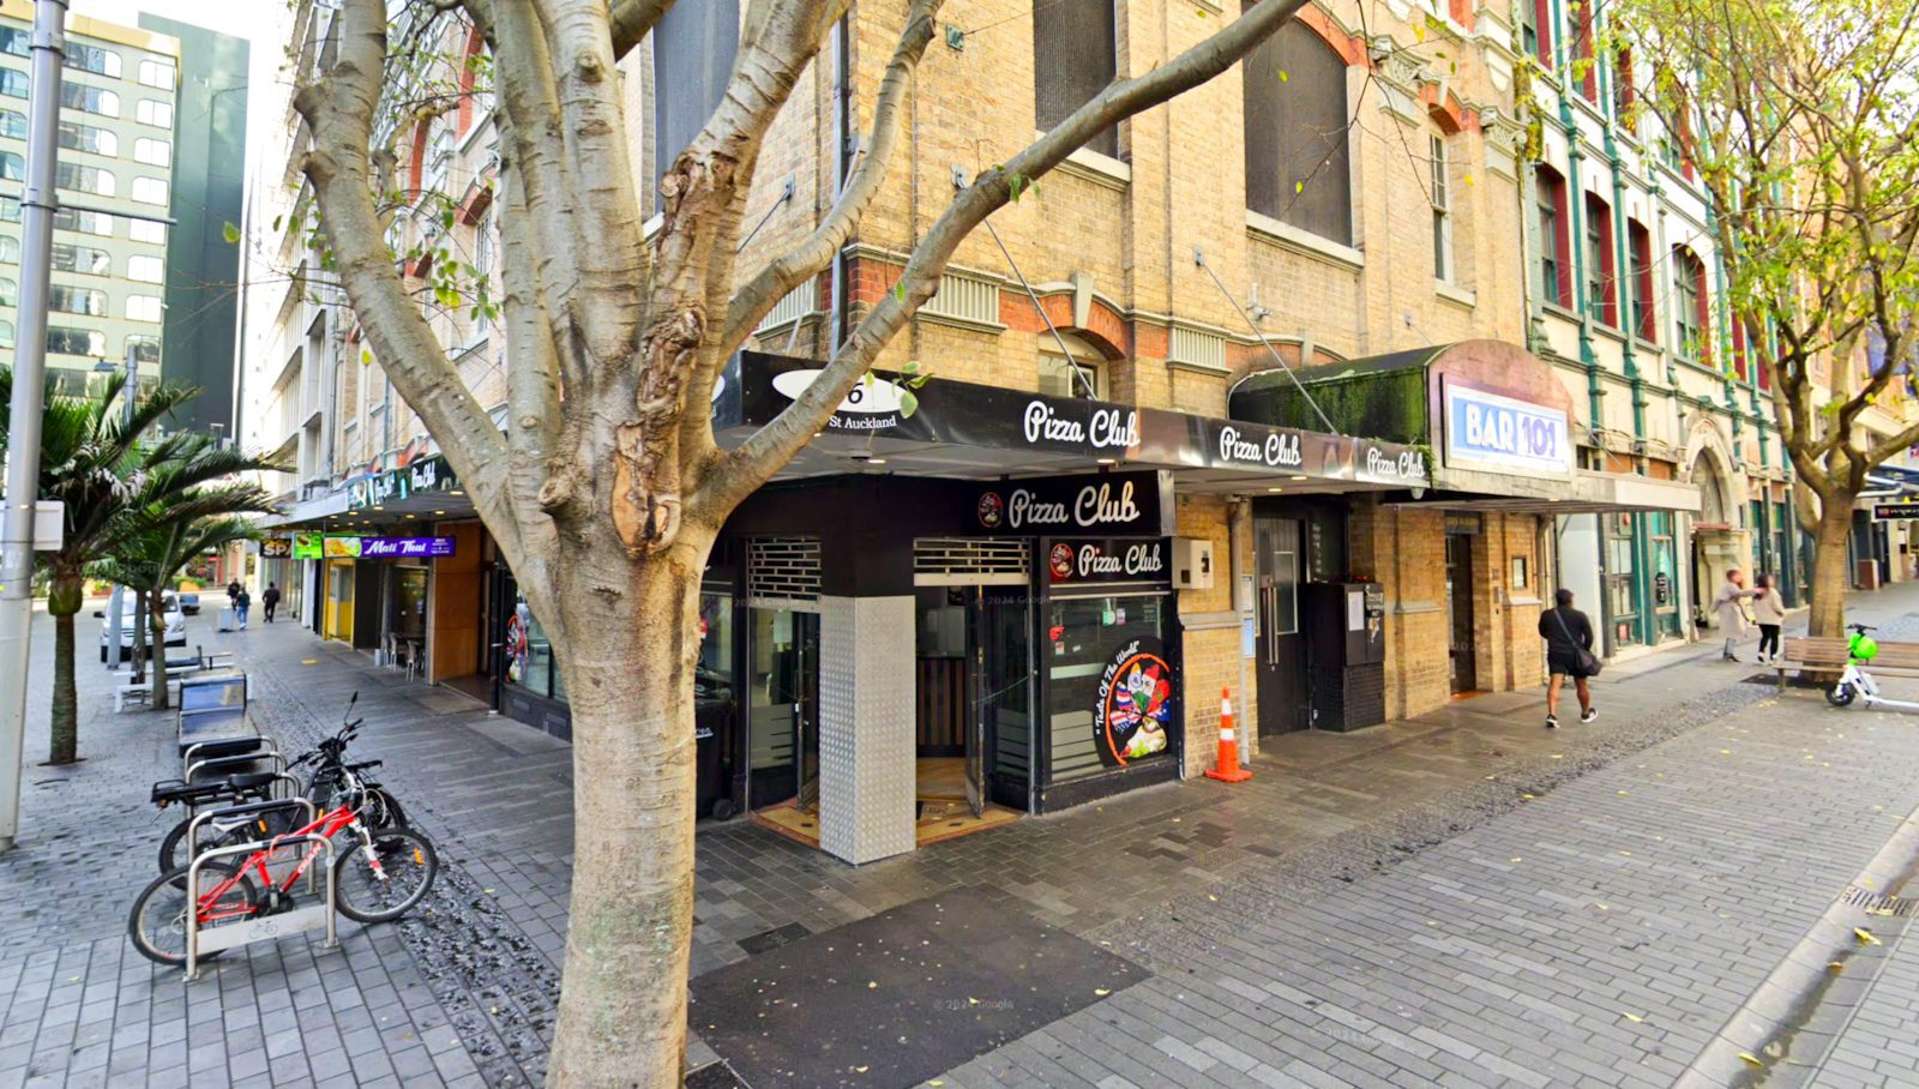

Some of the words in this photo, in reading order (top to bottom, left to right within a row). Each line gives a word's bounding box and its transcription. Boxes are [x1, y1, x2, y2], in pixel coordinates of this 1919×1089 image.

[846, 414, 897, 429] Auckland
[1024, 401, 1085, 442] Pizza
[1089, 409, 1141, 447] Club
[1466, 402, 1516, 454] BAR
[1521, 415, 1556, 457] 101
[1220, 426, 1262, 461] Pizza
[1265, 434, 1301, 466] Club
[1367, 447, 1397, 476] Pizza
[1398, 451, 1425, 478] Club
[1009, 489, 1069, 528] Pizza
[1075, 480, 1141, 527] Club
[1078, 544, 1122, 577] Pizza
[1125, 543, 1163, 575] Club
